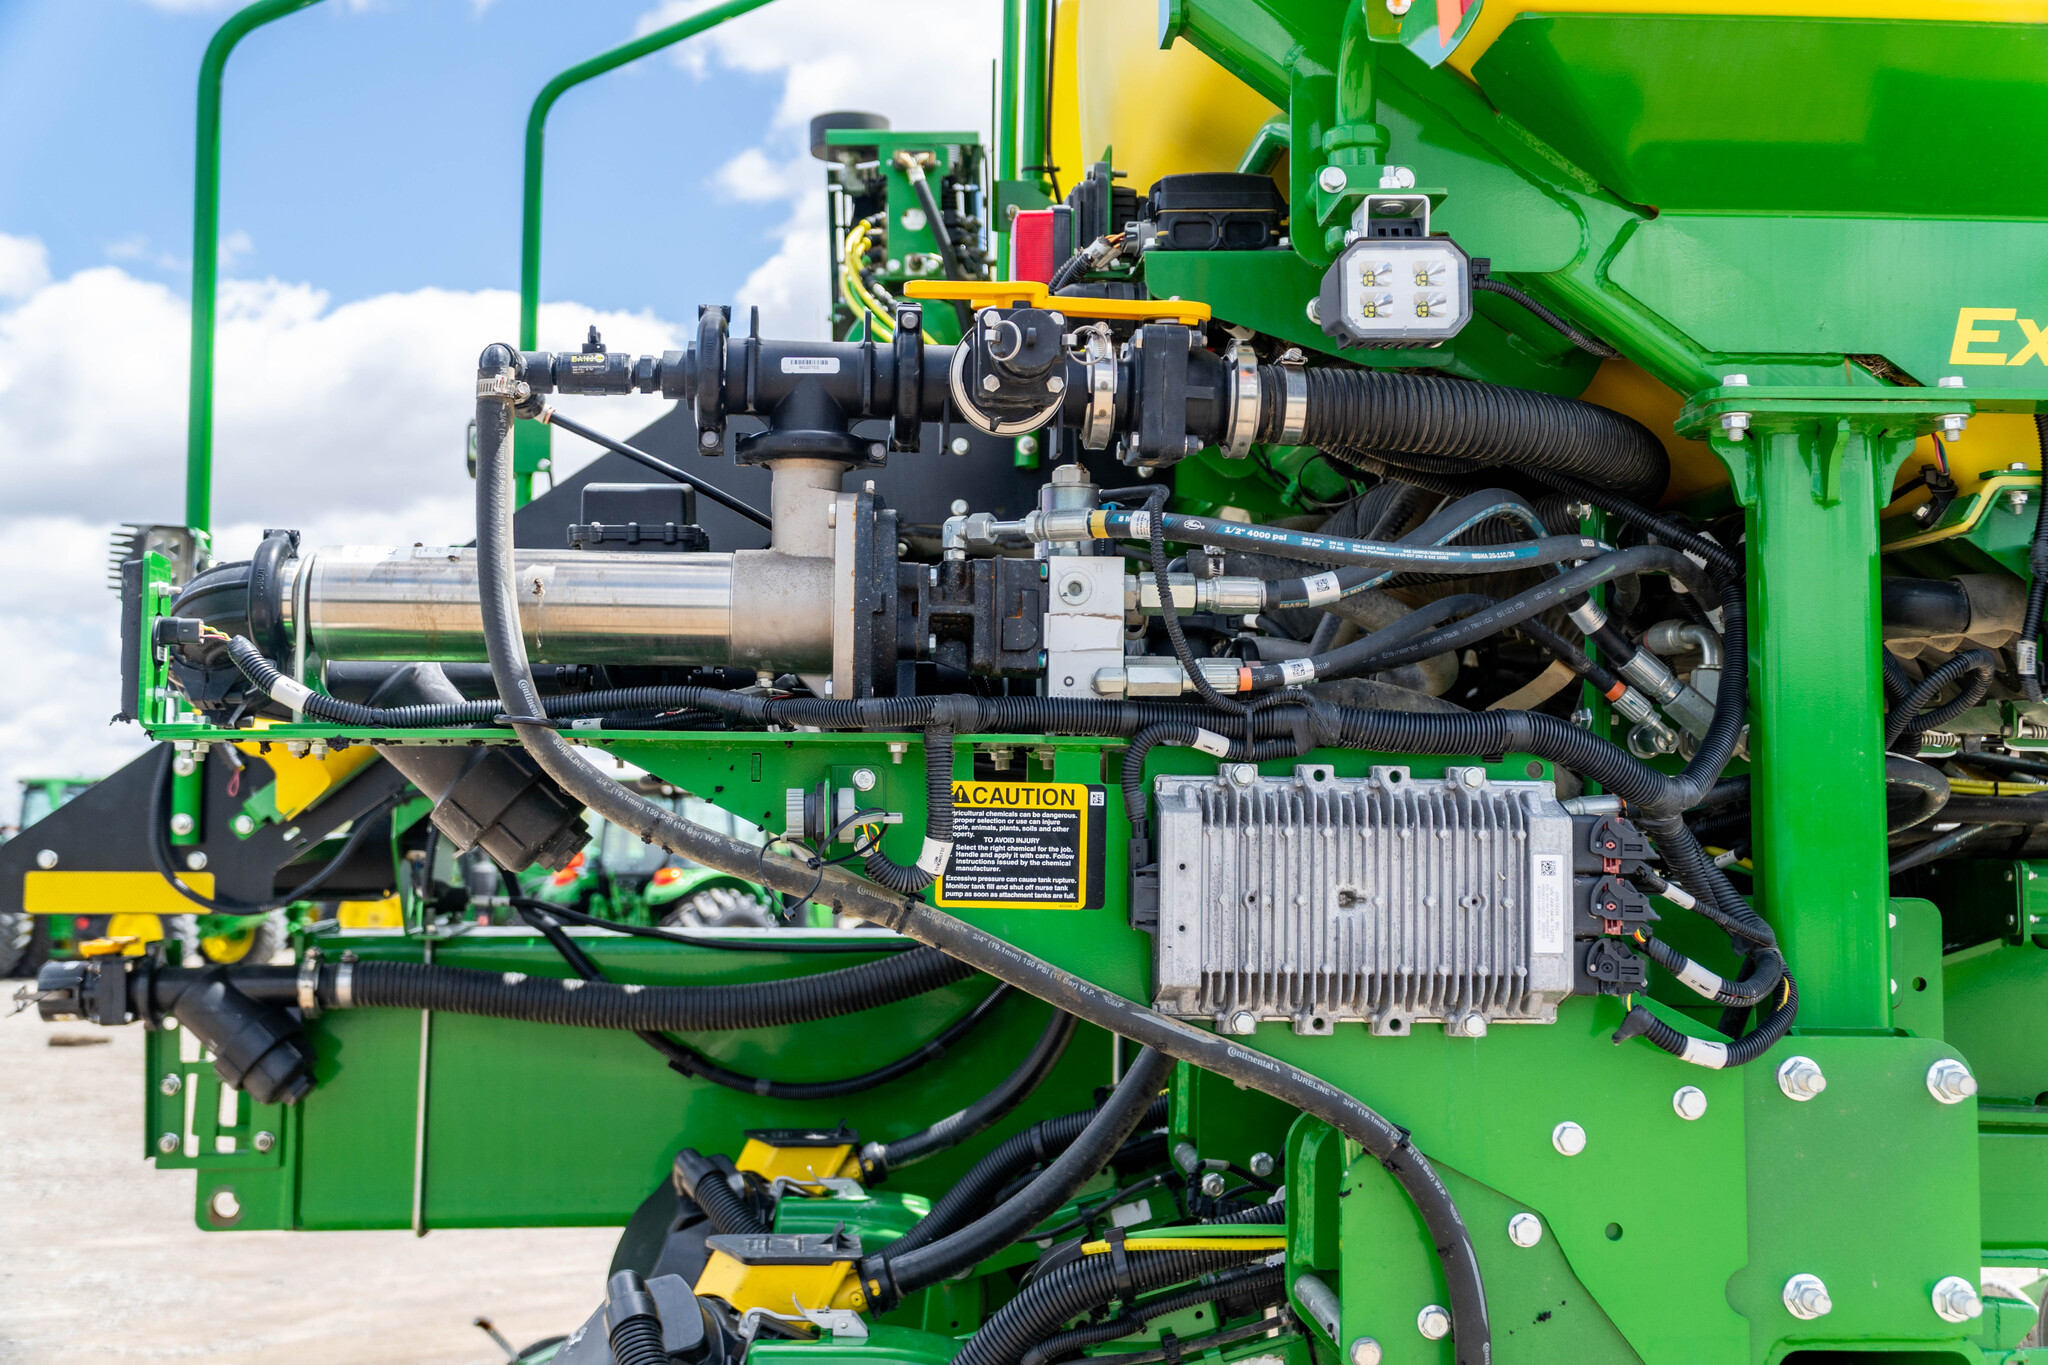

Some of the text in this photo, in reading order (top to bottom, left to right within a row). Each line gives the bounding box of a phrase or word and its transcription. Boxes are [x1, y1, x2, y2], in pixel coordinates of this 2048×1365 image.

[1948, 307, 2048, 366] Ex
[1247, 530, 1271, 540] 4000
[1272, 533, 1288, 542] psi
[1431, 636, 1443, 645] USA
[1443, 629, 1460, 640] Made
[1471, 616, 1494, 630] Mexico
[596, 776, 612, 787] 3/4"
[645, 807, 659, 818] 150
[660, 812, 673, 824] PSI
[673, 820, 686, 831] (10
[704, 833, 722, 846] W.P.
[973, 787, 1075, 806] CAUTION
[972, 932, 988, 943] 3/4"
[987, 940, 1022, 963] (19.1mm)
[1022, 957, 1036, 968] 150
[1036, 963, 1050, 975] PSI
[1049, 969, 1062, 981] (10
[1062, 976, 1079, 991] Bar)
[1079, 984, 1096, 998] W.P.
[1227, 1046, 1275, 1071] Continental
[1342, 1097, 1358, 1109] 3/4"
[1357, 1106, 1390, 1133] (19.1mm)
[1412, 1152, 1424, 1165] (10
[1423, 1164, 1436, 1182] Bar)
[1433, 1177, 1447, 1199] W.P.
